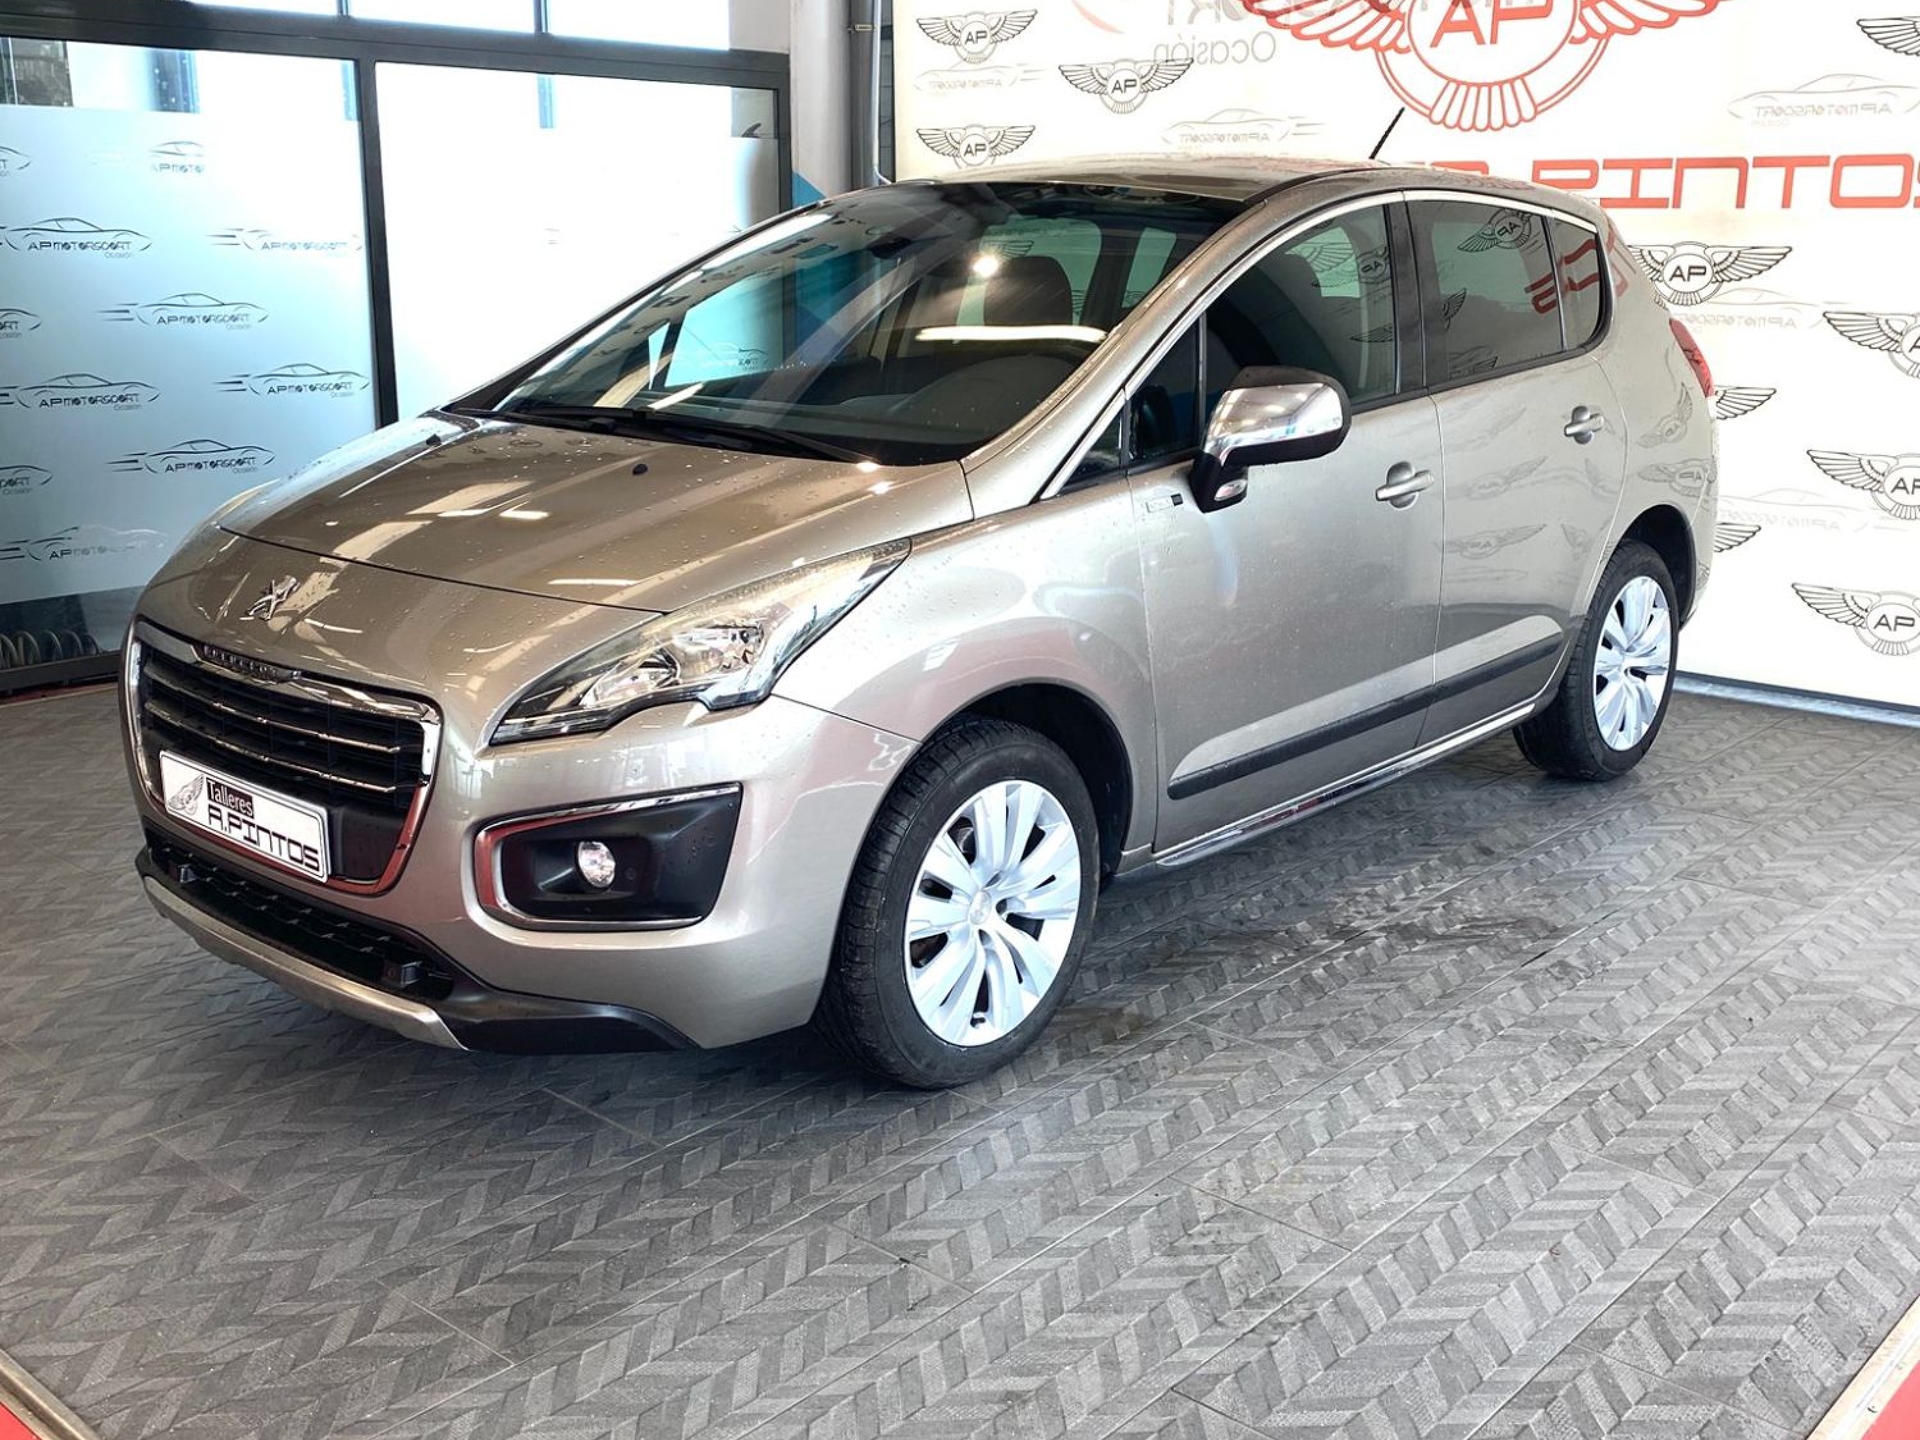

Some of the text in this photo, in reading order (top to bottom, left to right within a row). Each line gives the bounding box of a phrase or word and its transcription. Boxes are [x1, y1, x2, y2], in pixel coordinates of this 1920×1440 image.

[965, 30, 988, 45] AP
[1111, 79, 1138, 94] AP
[964, 143, 987, 157] AP
[1531, 153, 1920, 210] PINTO
[1668, 265, 1707, 282] AP
[1873, 613, 1917, 632] AP
[207, 780, 254, 817] Talleres
